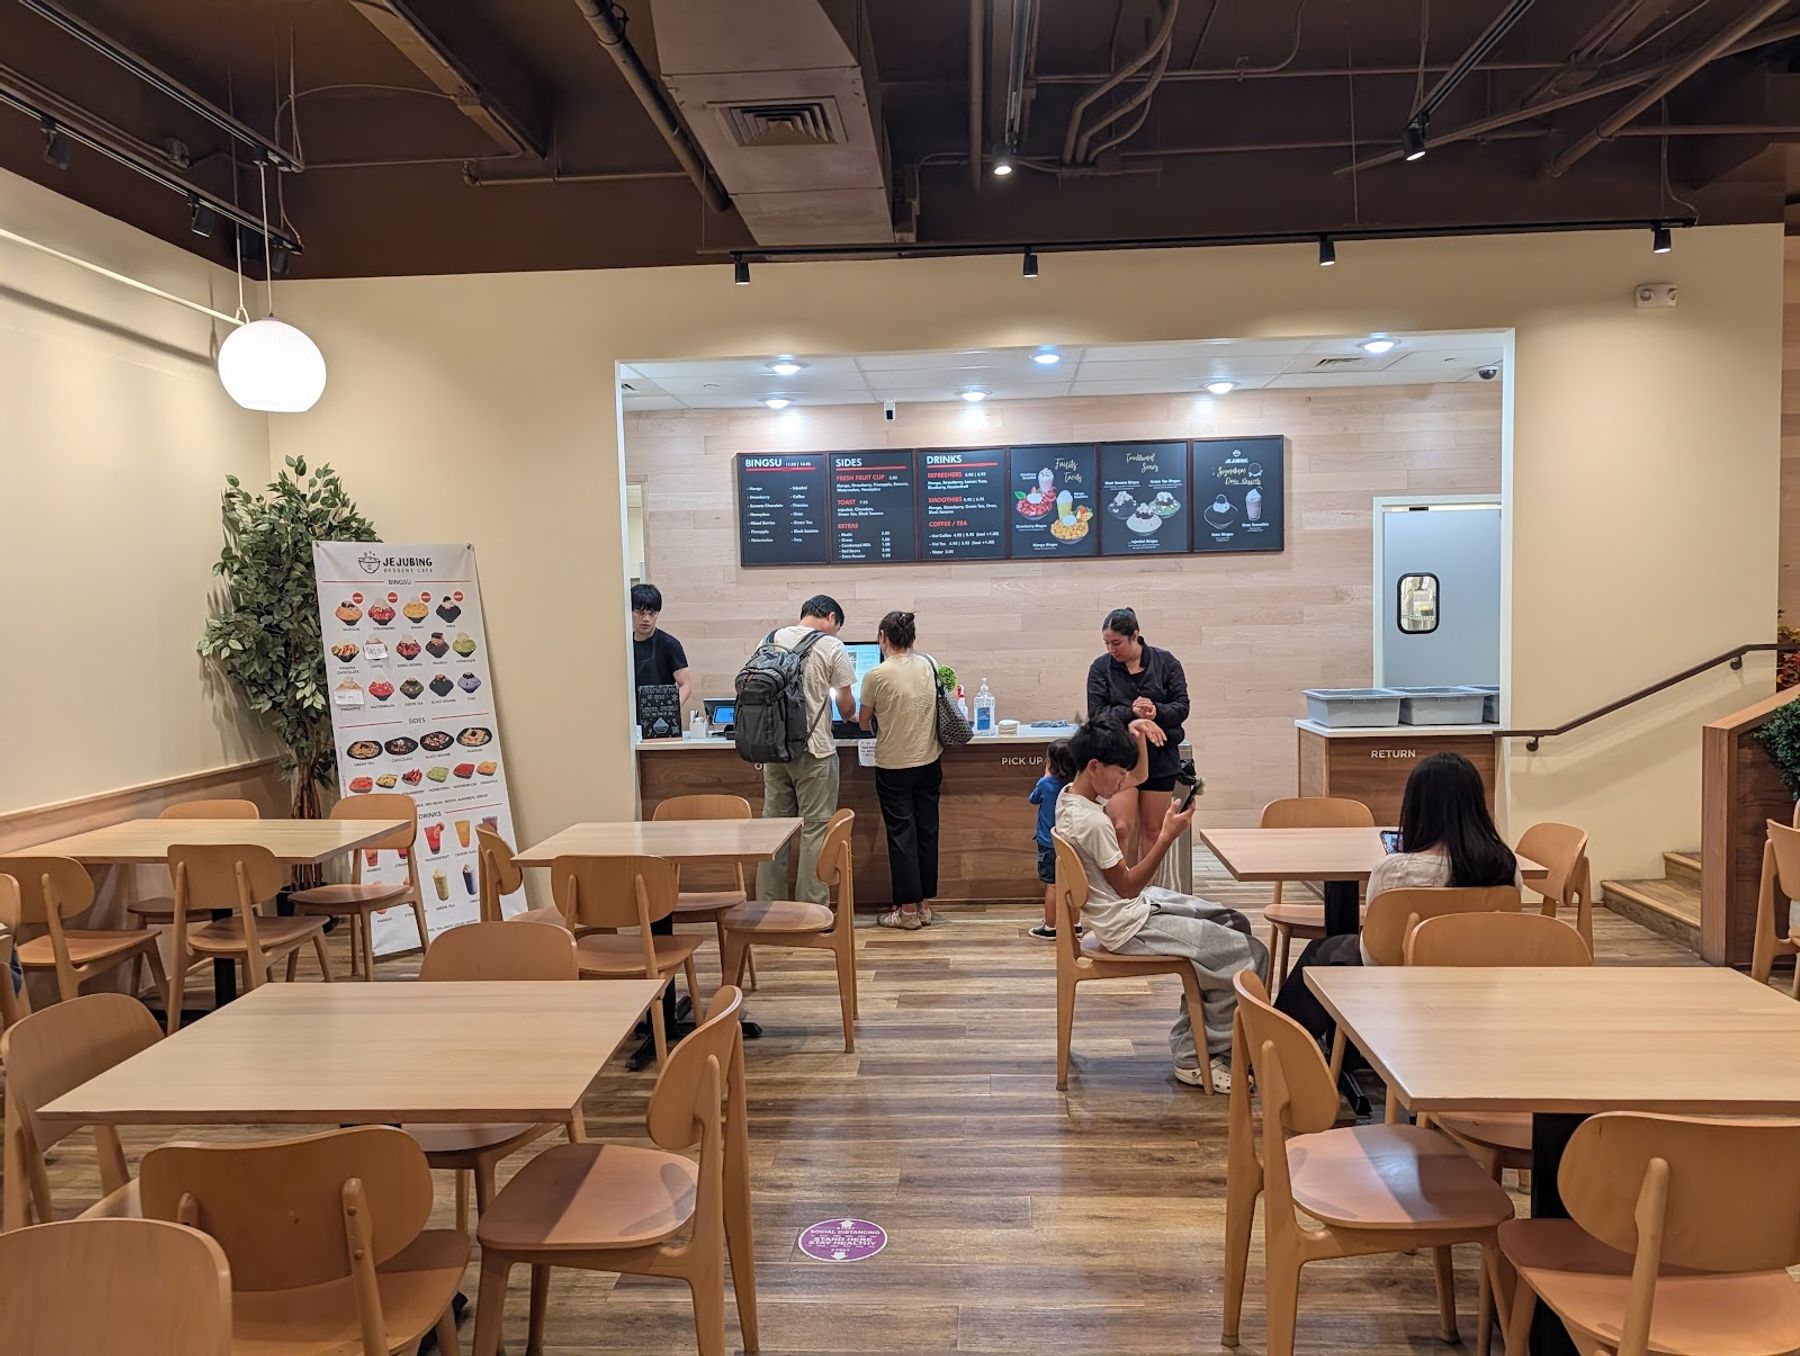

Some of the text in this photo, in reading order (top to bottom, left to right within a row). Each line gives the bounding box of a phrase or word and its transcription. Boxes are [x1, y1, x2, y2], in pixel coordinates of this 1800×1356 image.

[745, 458, 782, 468] BINGSU
[835, 458, 863, 467] SIDES
[926, 455, 962, 464] DRINKS
[382, 557, 433, 567] JEJUBING
[408, 717, 426, 725] SIDES
[1371, 749, 1416, 759] RETURN
[1001, 757, 1044, 765] PICK UP
[418, 811, 442, 820] DRINKS
